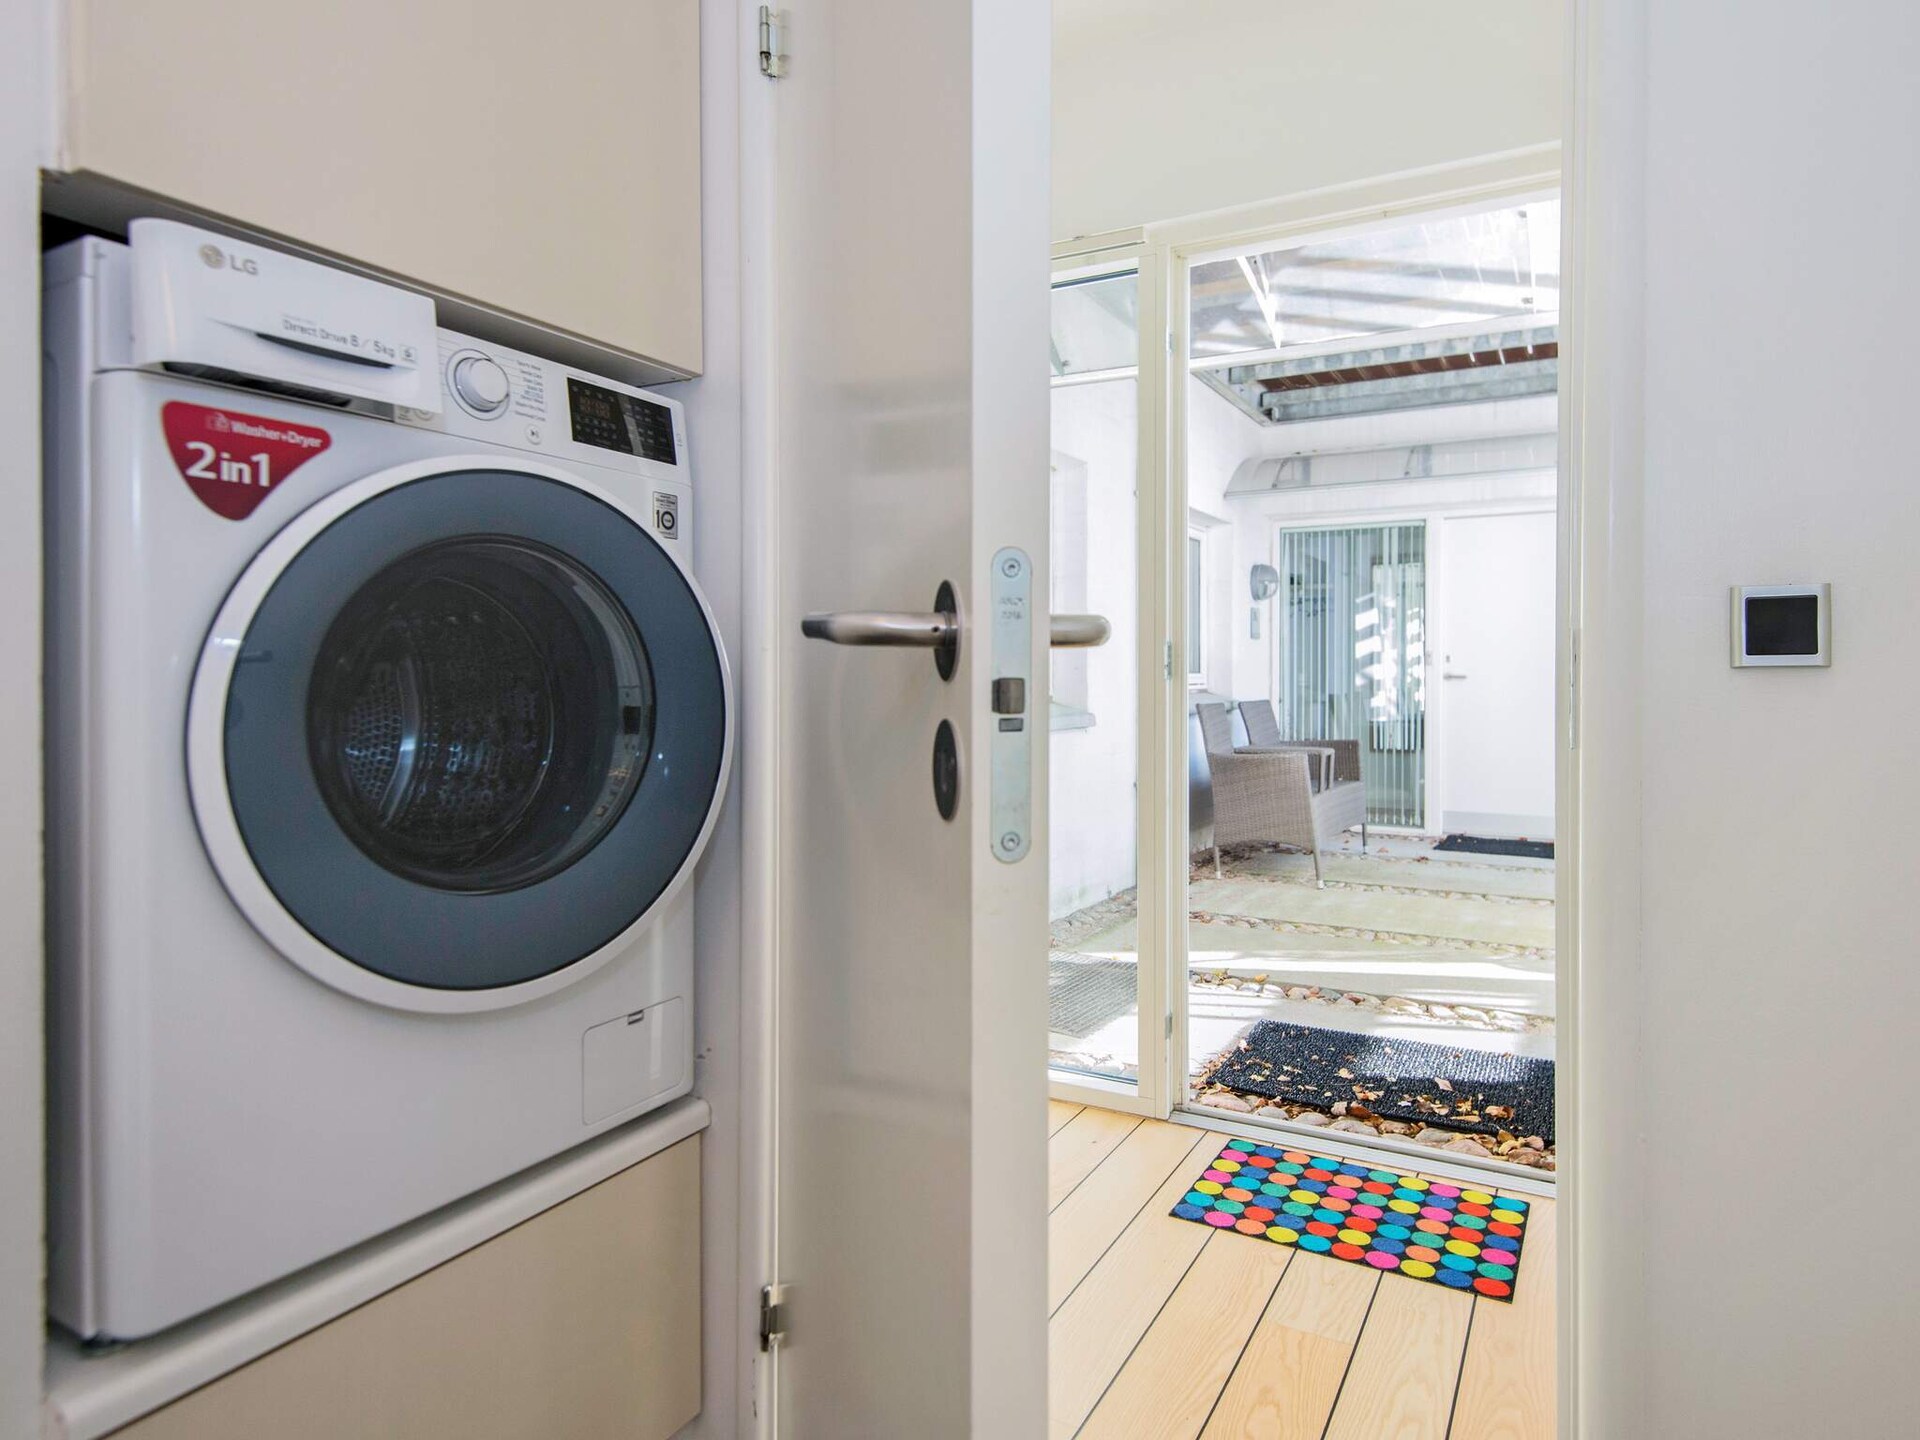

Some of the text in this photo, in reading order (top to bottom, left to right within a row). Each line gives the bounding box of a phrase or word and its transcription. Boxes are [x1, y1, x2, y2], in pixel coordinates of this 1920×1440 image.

[230, 255, 258, 275] LG
[282, 318, 317, 338] Direct
[319, 327, 348, 345] Drive
[656, 509, 675, 530] 10
